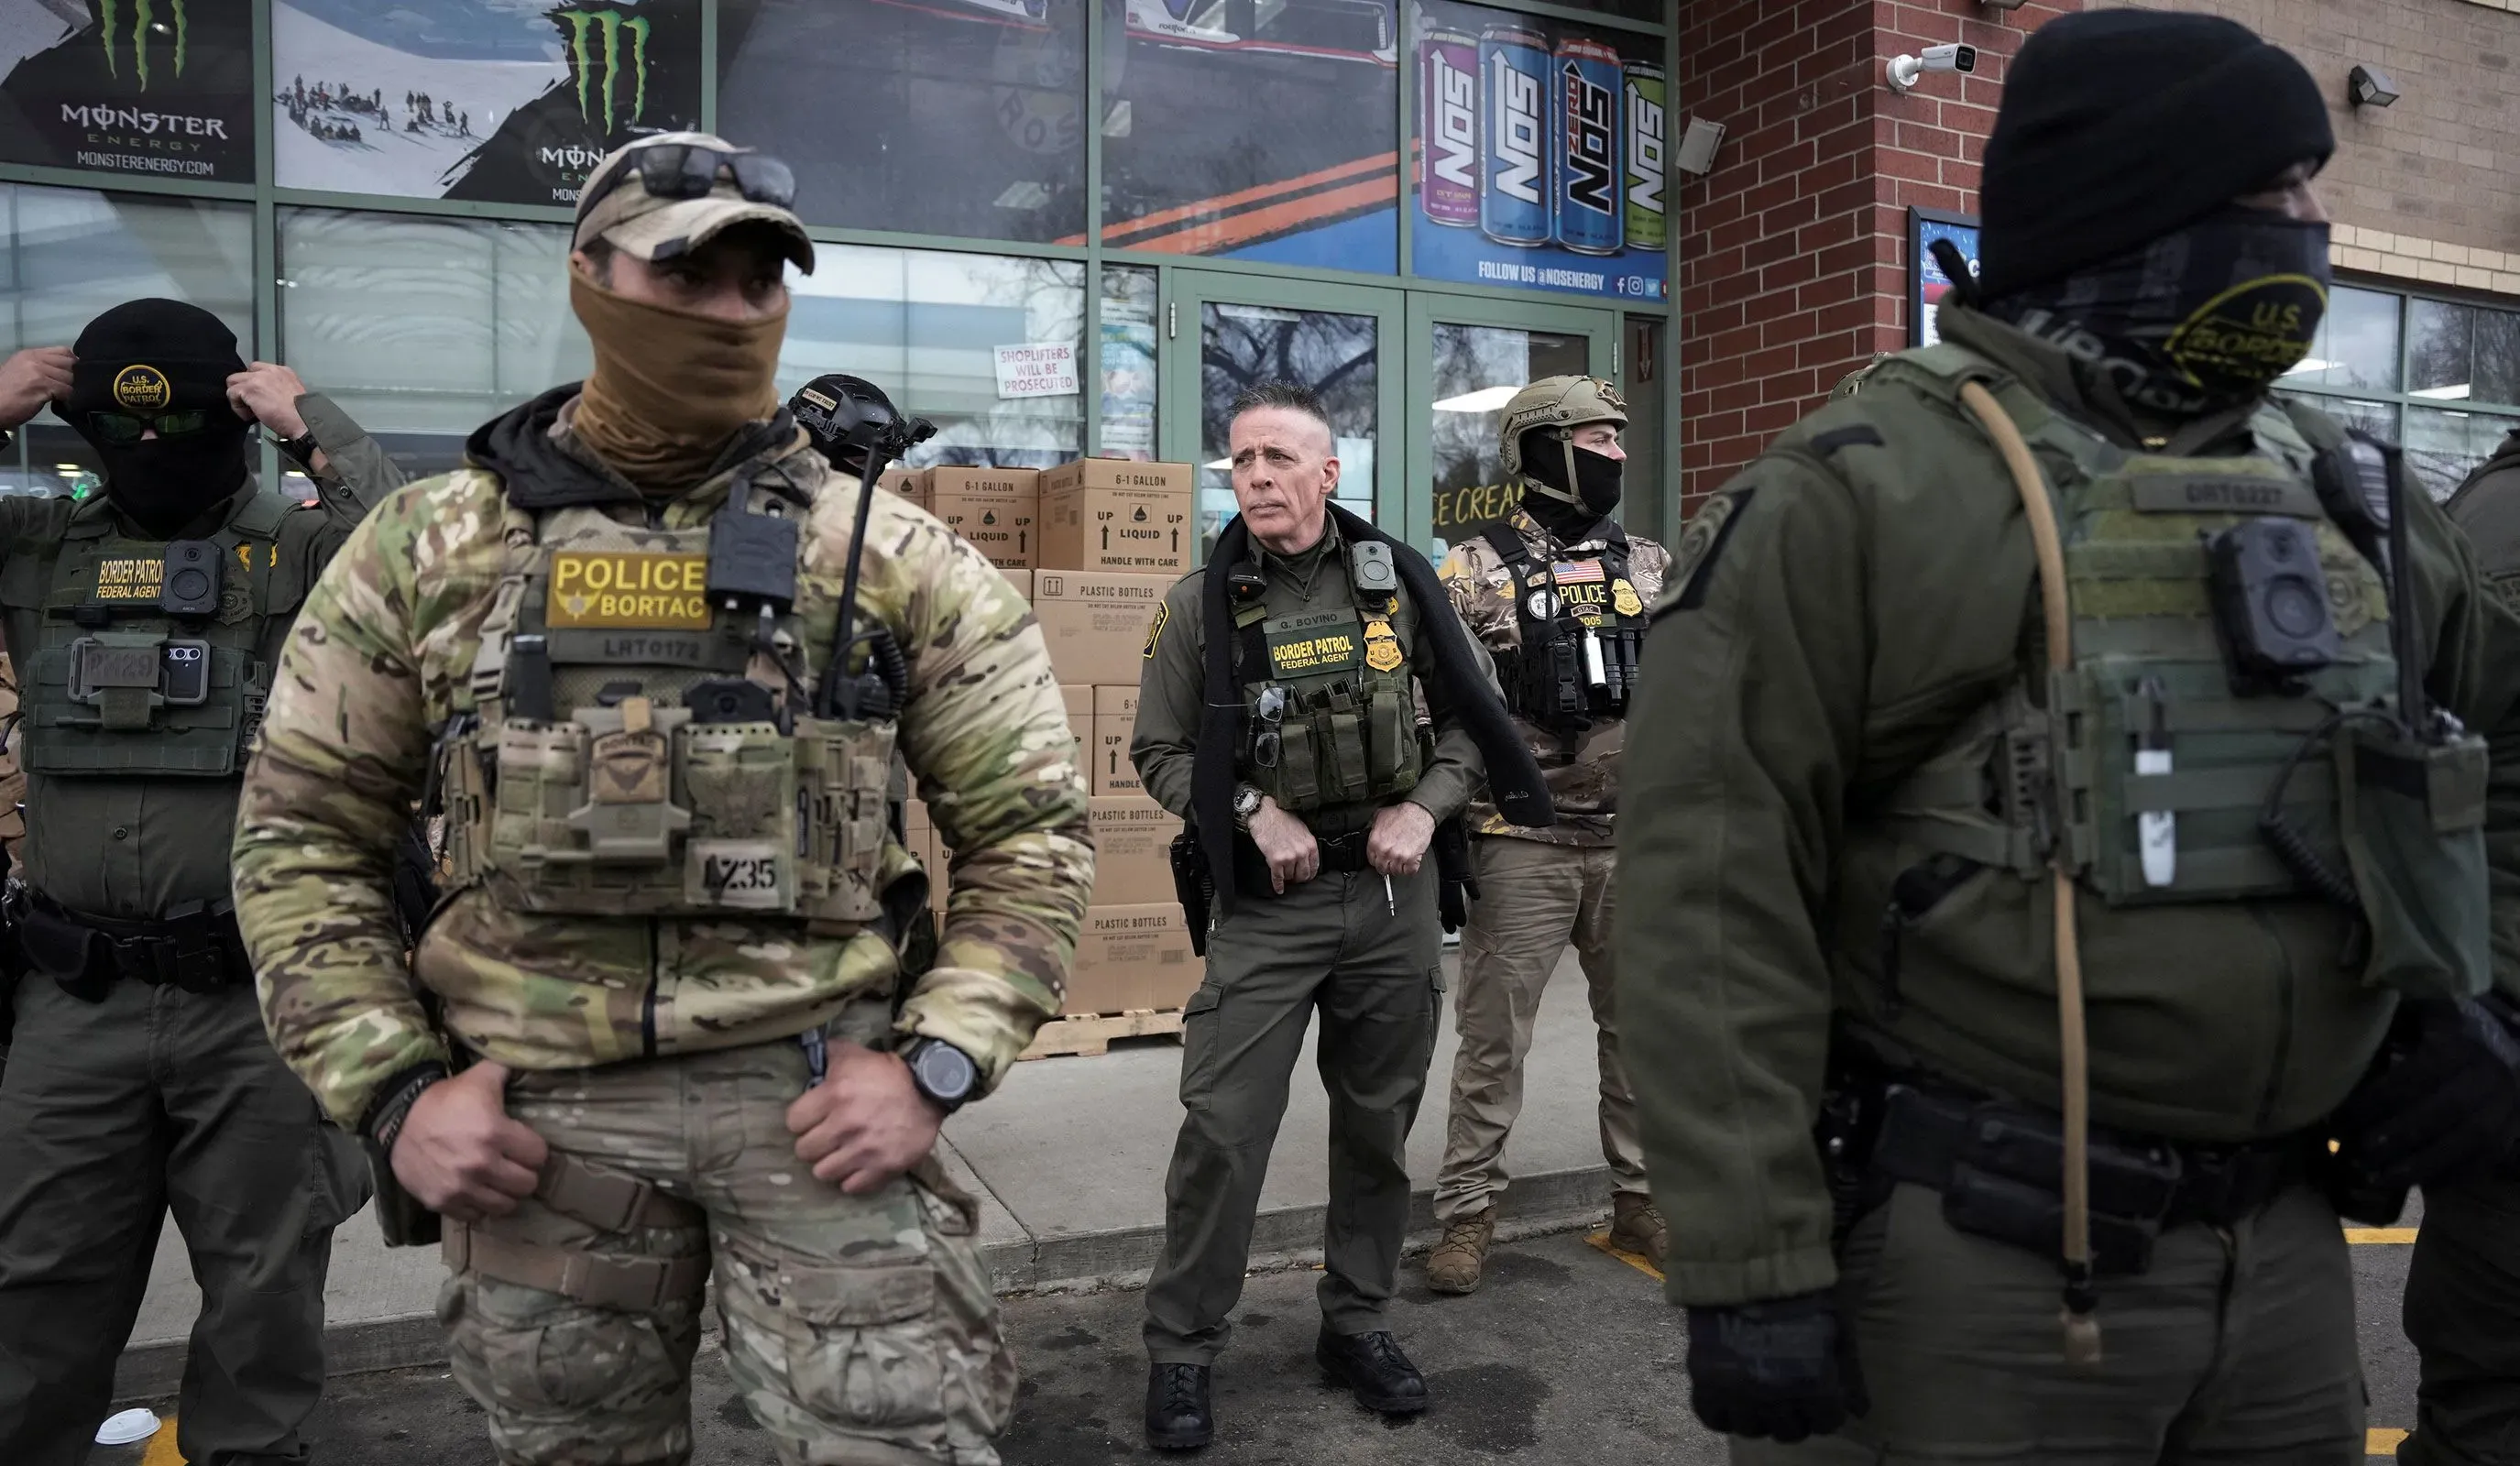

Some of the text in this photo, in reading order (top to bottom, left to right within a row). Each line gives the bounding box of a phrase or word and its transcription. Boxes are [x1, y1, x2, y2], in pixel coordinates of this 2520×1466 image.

[60, 104, 228, 139] MONSTER
[1430, 49, 1474, 189] NOS
[1567, 76, 1580, 156] ZERO
[1491, 47, 1539, 206] NOS
[88, 133, 202, 152] ENERGY
[1562, 60, 1612, 215] NOS
[1626, 80, 1664, 215] NOS
[77, 150, 214, 175] MONSTERENERGY.COM
[1478, 260, 1605, 290] FOLLOW US @NOSENERGY
[1000, 347, 1070, 364] SHOPLIFTERS
[1015, 363, 1057, 377] WILL BE
[132, 375, 149, 384] U.S.
[1003, 377, 1072, 392] PROSECUTED
[122, 385, 161, 394] BORDER
[965, 481, 1013, 492] 6-1 GALLON
[1115, 475, 1166, 487] 6-1 GALLON
[948, 516, 964, 524] UP
[1014, 518, 1031, 526] UP
[1098, 511, 1114, 520] UP
[1167, 514, 1183, 523] UP
[970, 531, 1009, 542] LIQUID
[1120, 529, 1160, 539] LIQUID
[1006, 559, 1026, 567] CARE
[1101, 556, 1178, 566] HANDLE WITH CARE
[98, 560, 134, 584] BORDER
[555, 557, 707, 592] POLICE
[95, 585, 162, 598] FEDERAL AGENT
[1080, 585, 1154, 598] PLASTIC BOTTLES
[1558, 585, 1607, 605] POLICE
[600, 594, 704, 618] BORTAC
[1280, 613, 1338, 629] G. BOVINO
[1273, 635, 1353, 662] BORDER PATROL
[1280, 652, 1350, 670] FEDERAL AGENT
[1105, 736, 1122, 745] UP
[1109, 780, 1140, 789] HANDLE
[1092, 810, 1164, 821] PLASTIC BOTTLES
[1095, 916, 1167, 929] PLASTIC BOTTLES
